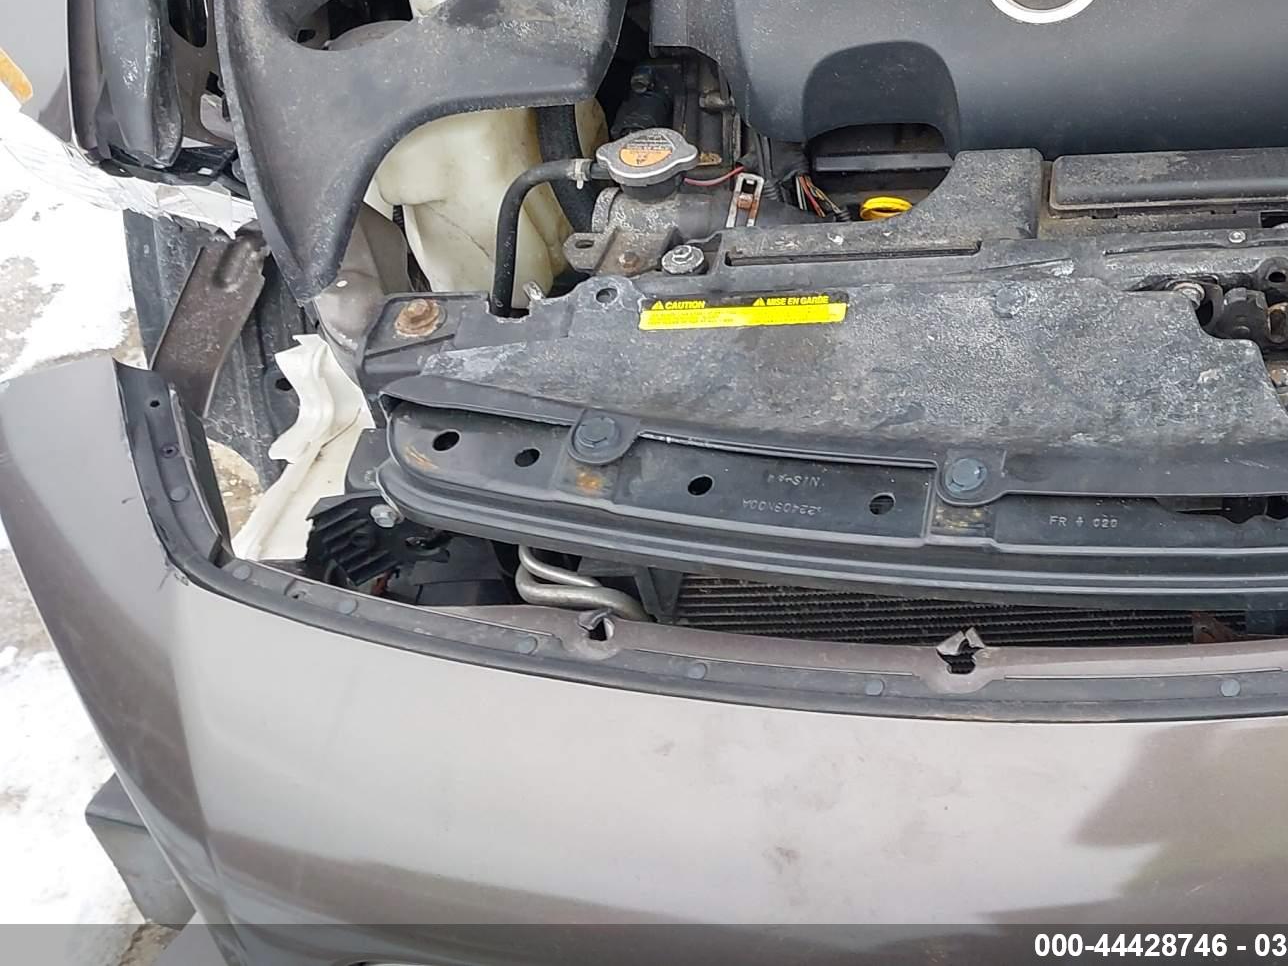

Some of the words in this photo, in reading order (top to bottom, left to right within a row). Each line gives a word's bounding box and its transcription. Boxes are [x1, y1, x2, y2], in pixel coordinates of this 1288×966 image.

[664, 300, 706, 310] CAUTION
[766, 297, 787, 306] MISE
[787, 296, 800, 305] EN
[800, 295, 829, 304] GARDE
